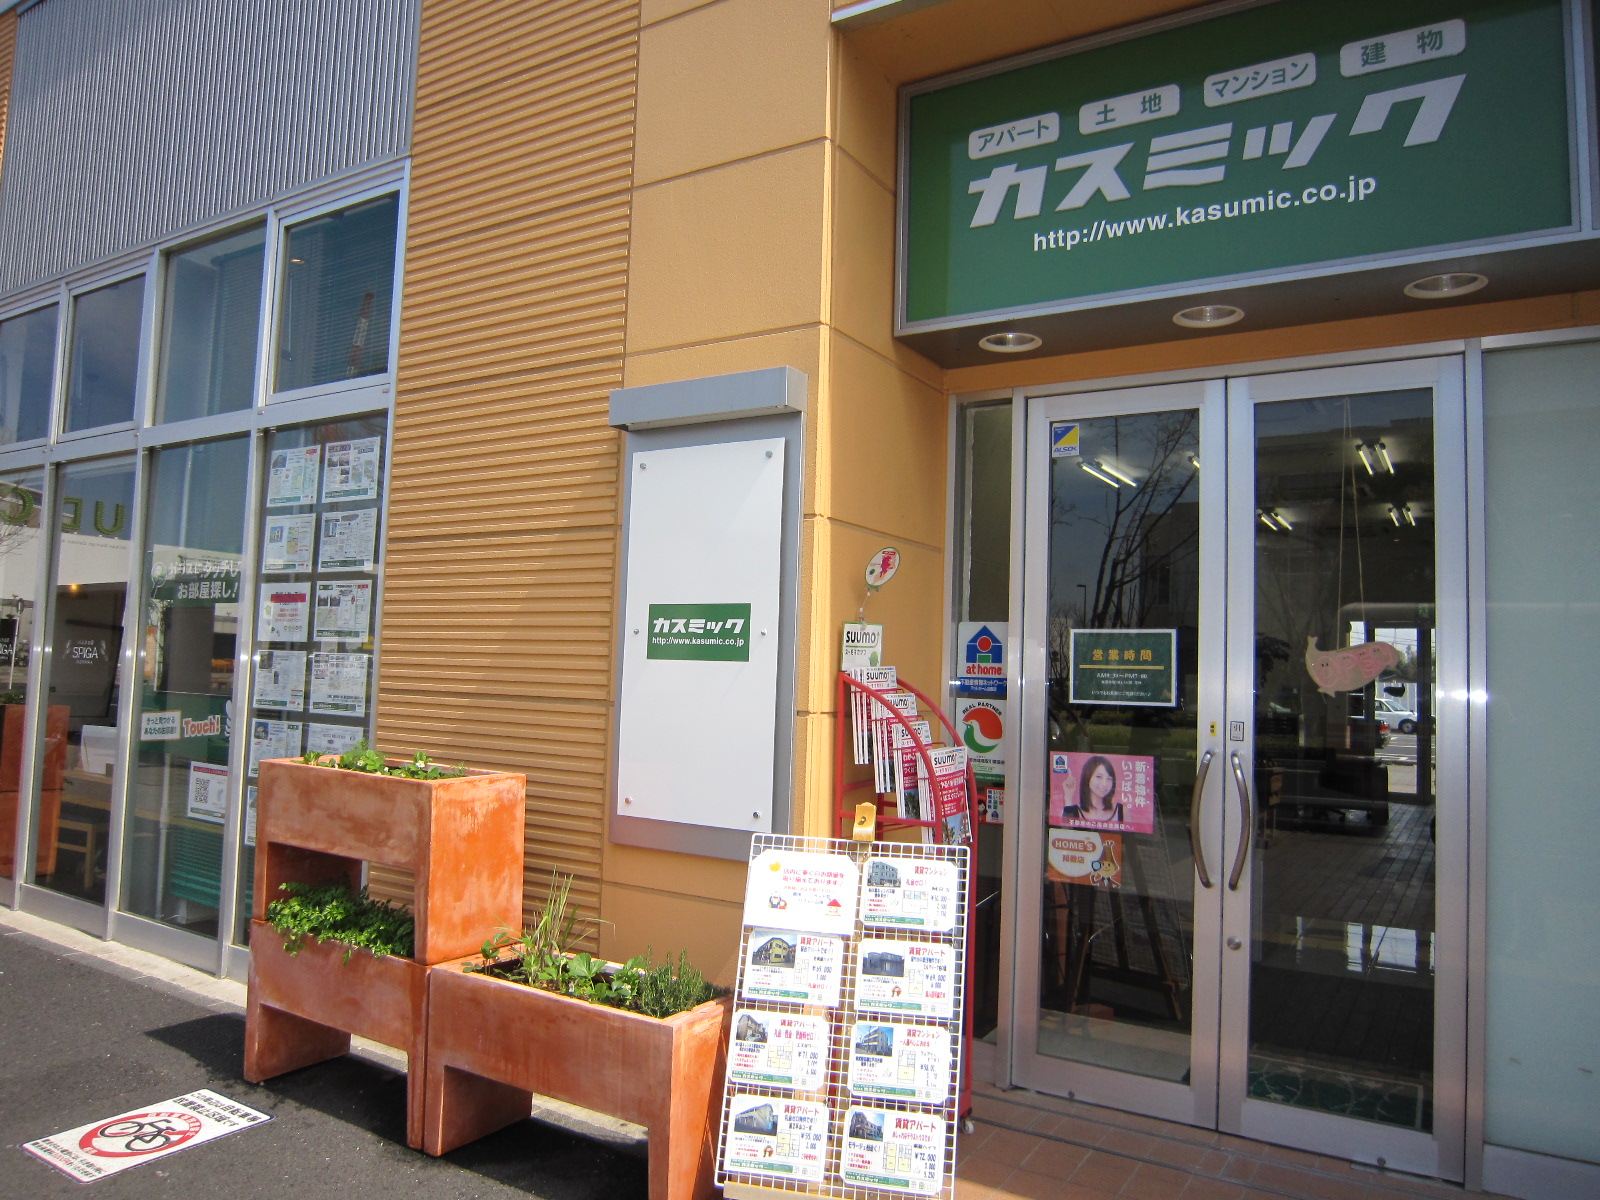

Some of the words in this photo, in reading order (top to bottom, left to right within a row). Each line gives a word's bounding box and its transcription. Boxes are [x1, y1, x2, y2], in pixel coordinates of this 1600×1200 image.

[1361, 31, 1443, 67] 建物
[1211, 61, 1309, 97] マンション
[1095, 93, 1162, 126] 土地
[977, 120, 1050, 152] アパート
[968, 73, 1467, 228] カスミック
[1033, 175, 1377, 252] http://www.kasumic.co.jp
[169, 560, 241, 578] ガラスにタッチし
[178, 582, 238, 599] お部屋探し！
[653, 618, 745, 634] カスミック
[652, 637, 745, 647] http://www.kasumic.co.jp
[72, 647, 98, 659] SPIGA
[1092, 649, 1152, 661] 営業時間
[966, 664, 976, 674] at
[978, 664, 1002, 675] home
[888, 699, 908, 707] UUMO
[962, 703, 975, 714] REAL
[978, 702, 1002, 716] PARTNER
[184, 716, 220, 736] Touch!
[1135, 761, 1146, 807] 新着物件
[1055, 840, 1093, 851] HOME'S
[915, 866, 948, 876] 賃貸マンション
[800, 937, 834, 947] 賃貸アパート
[909, 947, 945, 957] 賃貸アパート
[781, 1019, 816, 1029] 賃貸アパート
[907, 1029, 940, 1039] 賃貸マンション
[784, 1105, 819, 1116] 賃貸アパート
[895, 1118, 936, 1132] 賃貸アパート
